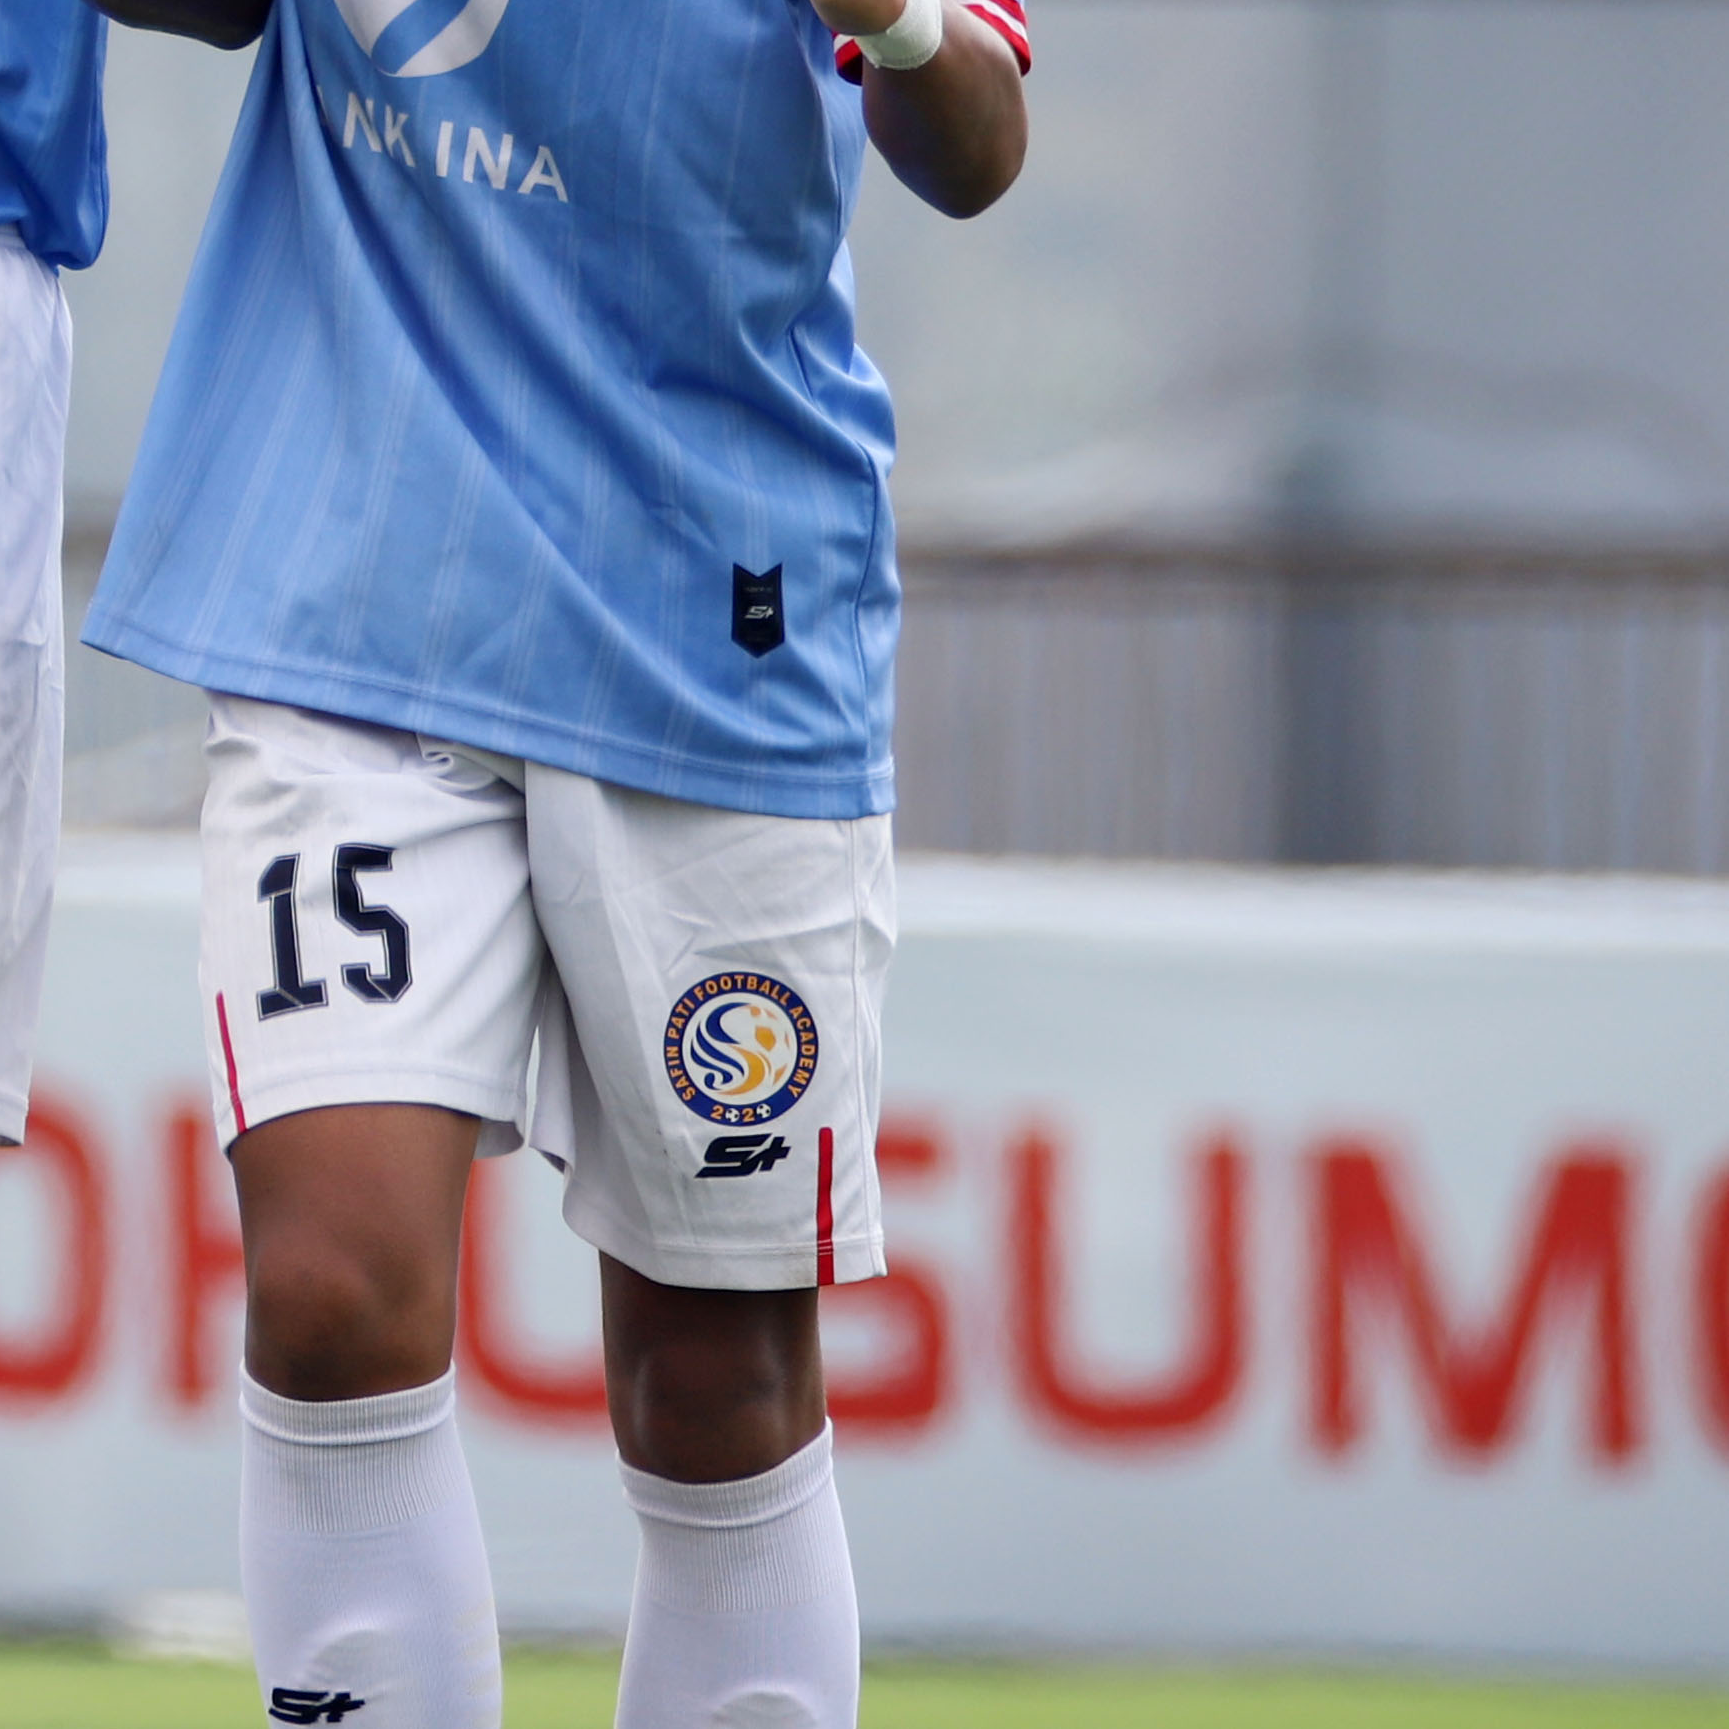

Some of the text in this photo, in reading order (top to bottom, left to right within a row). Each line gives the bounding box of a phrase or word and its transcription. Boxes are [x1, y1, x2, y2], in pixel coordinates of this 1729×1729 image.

[316, 85, 569, 203] NK INA
[256, 842, 413, 1022] 15
[666, 974, 816, 1102] SAFIN PATI FOOTBALL ACADEMY
